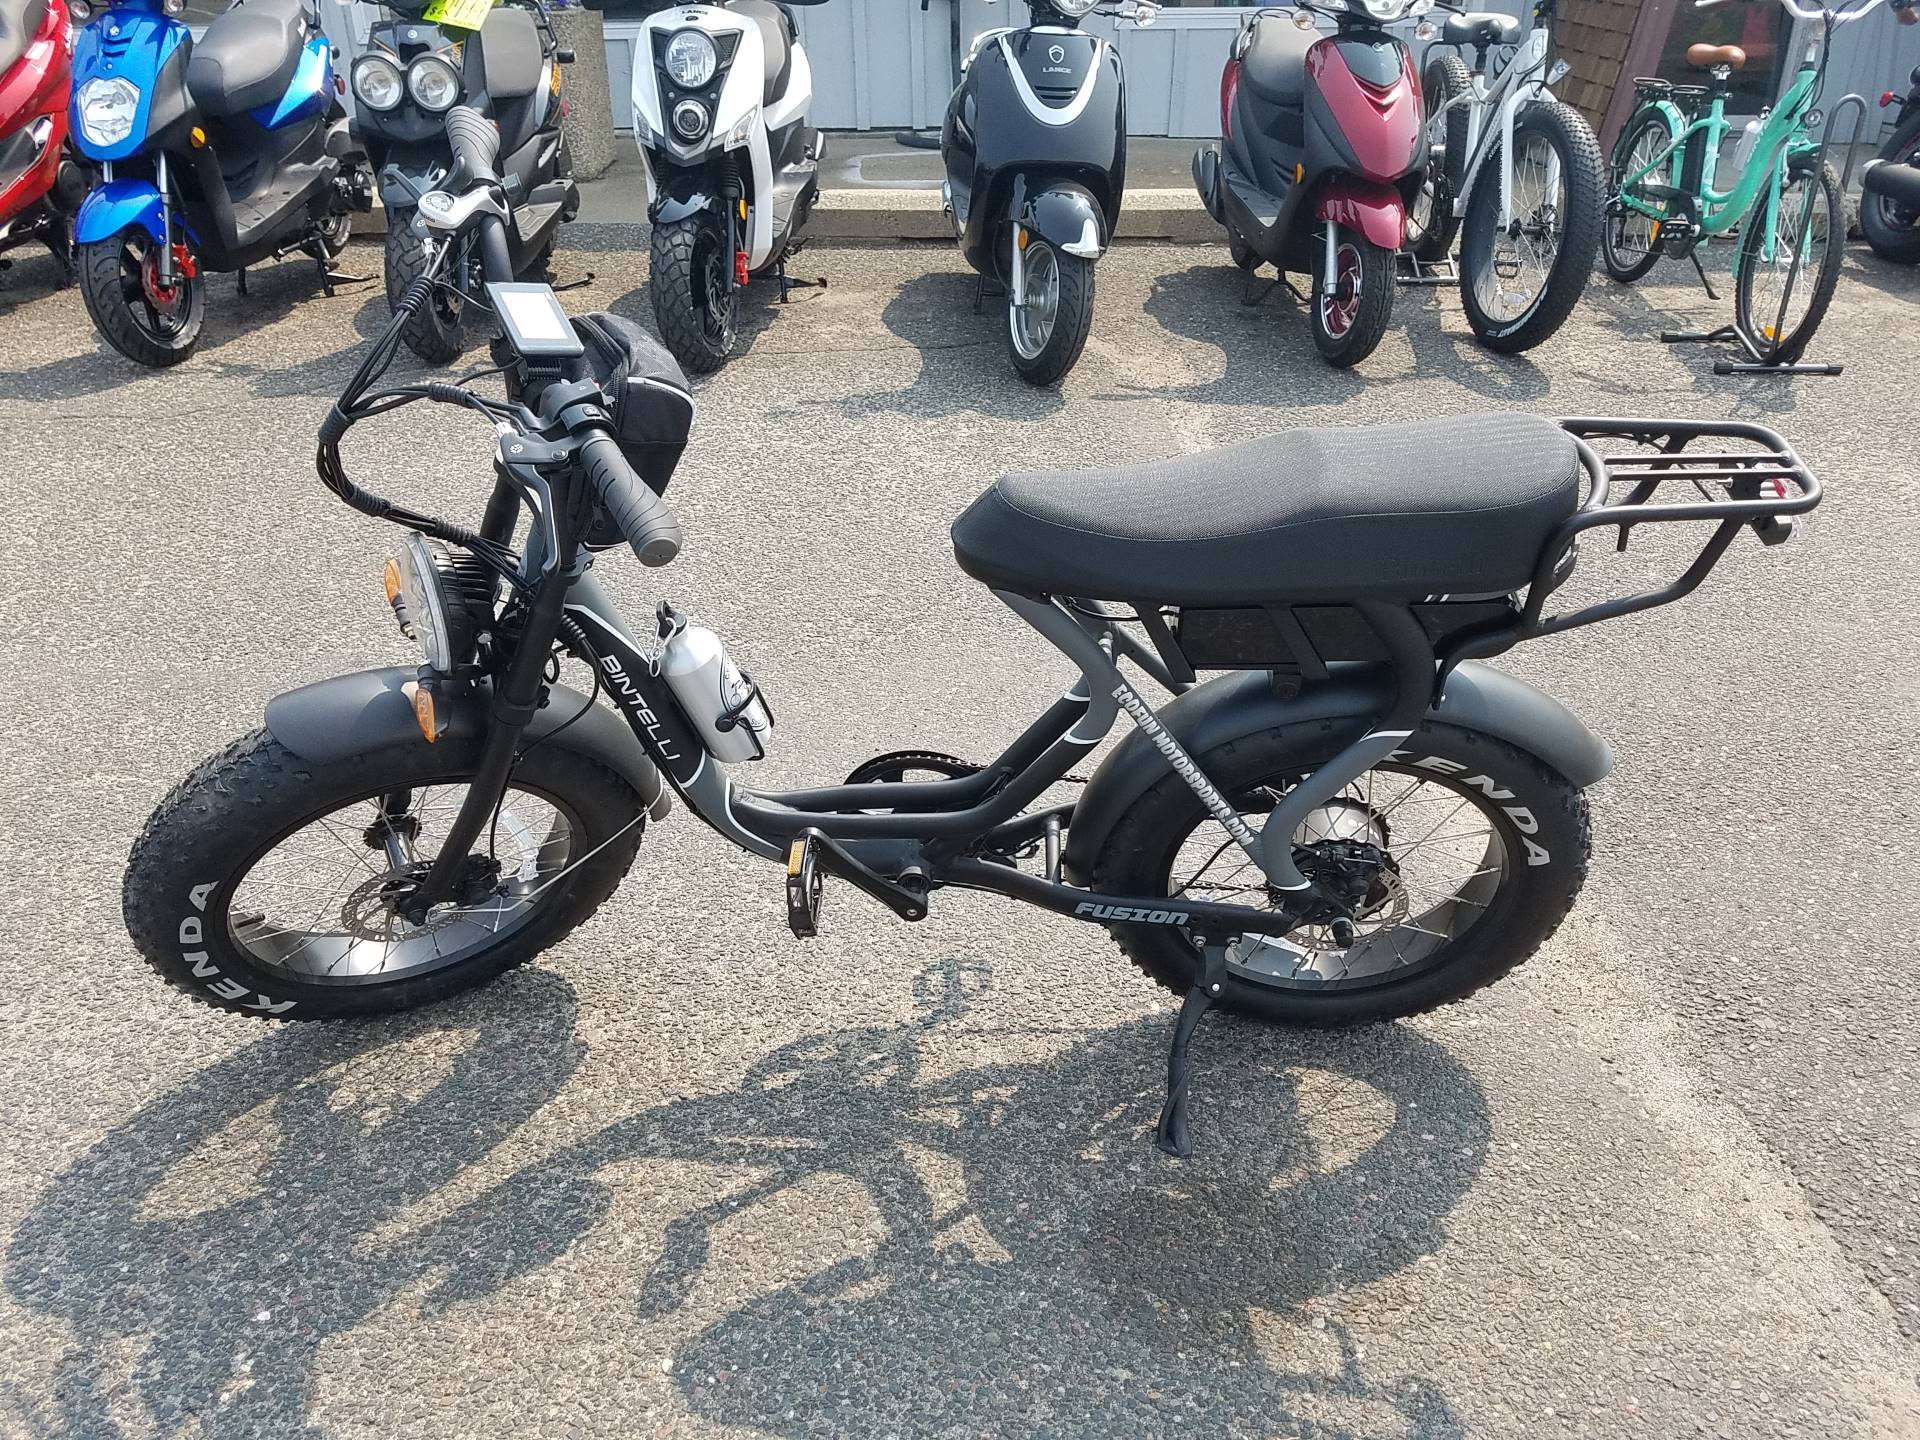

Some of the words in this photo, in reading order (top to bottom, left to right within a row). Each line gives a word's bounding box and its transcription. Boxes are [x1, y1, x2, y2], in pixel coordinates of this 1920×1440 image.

[1042, 66, 1072, 74] LANCE
[601, 655, 680, 760] BINTELLI
[1074, 902, 1190, 925] FUSION
[179, 880, 298, 1014] KENDA
